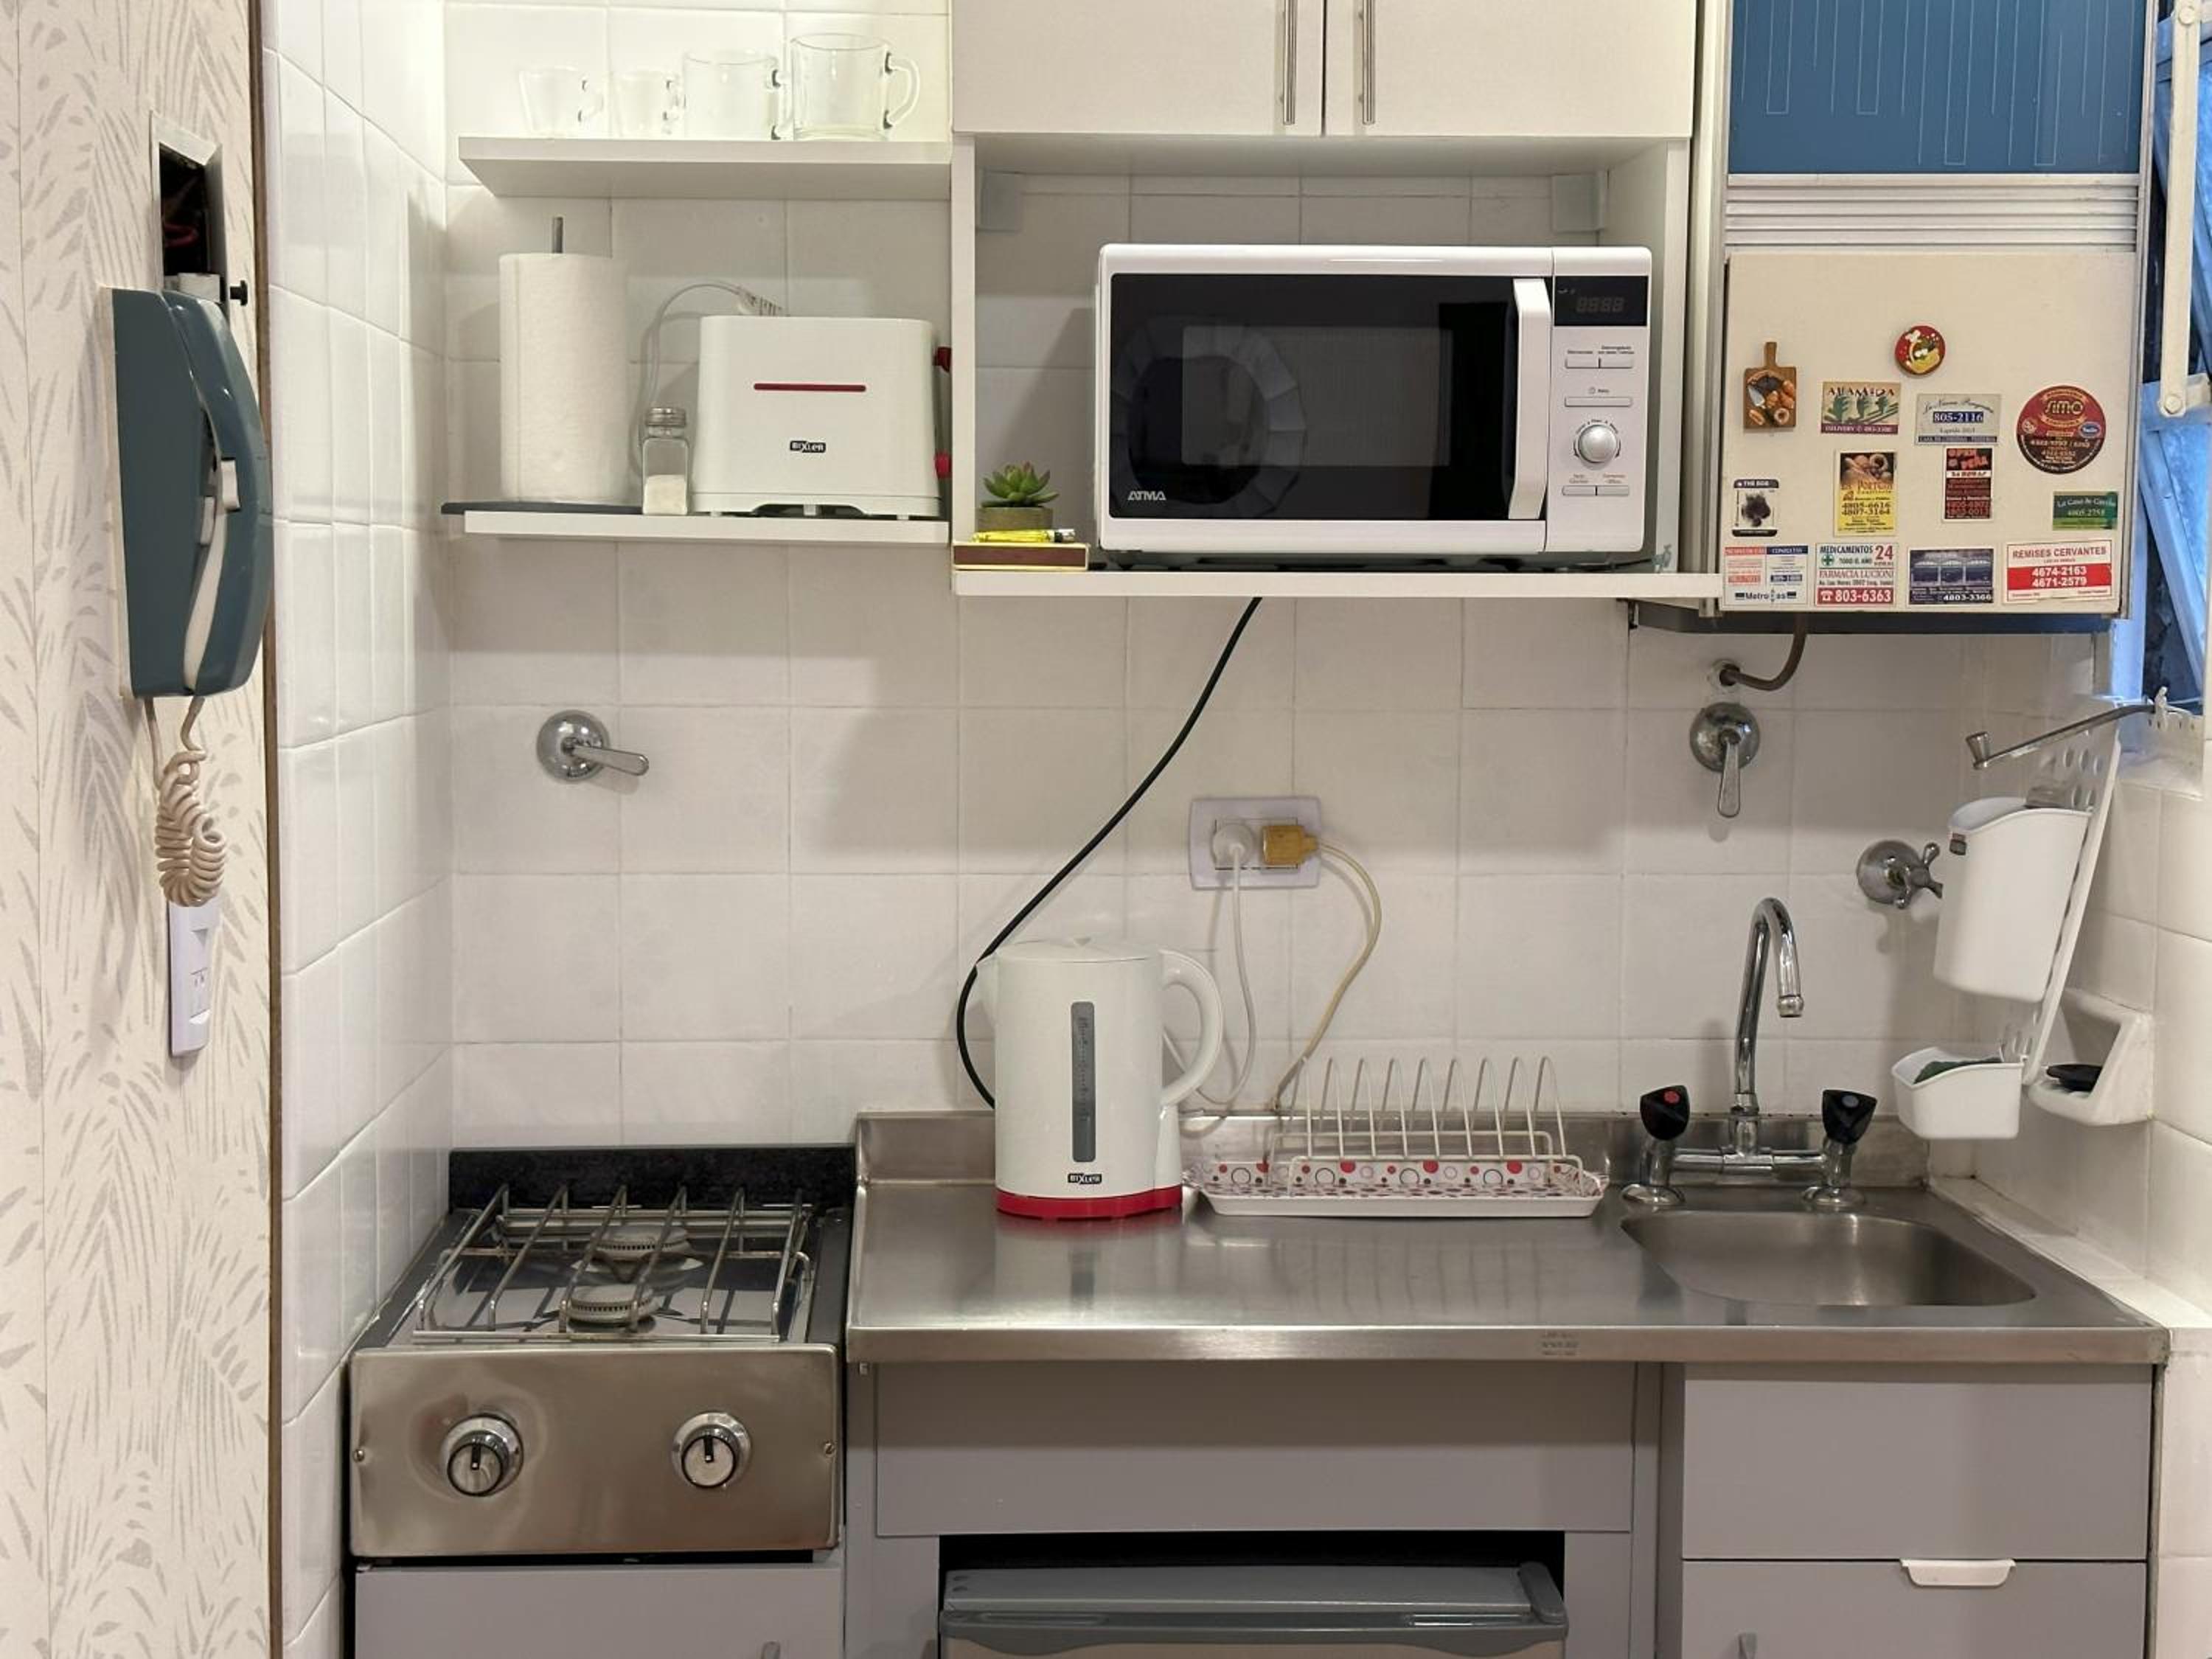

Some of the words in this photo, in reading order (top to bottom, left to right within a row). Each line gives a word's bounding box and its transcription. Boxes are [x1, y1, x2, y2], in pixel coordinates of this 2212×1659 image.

[1934, 412, 1983, 422] 805-2116
[1127, 490, 1166, 501] ATMA
[1820, 546, 1874, 554] MEDICAMENTOS
[1875, 545, 1893, 560] 24
[2012, 549, 2051, 559] REMISES
[2053, 546, 2107, 557] CERVANTES
[1819, 571, 1860, 579] FARMACIA
[1835, 589, 1891, 602] 803-6363
